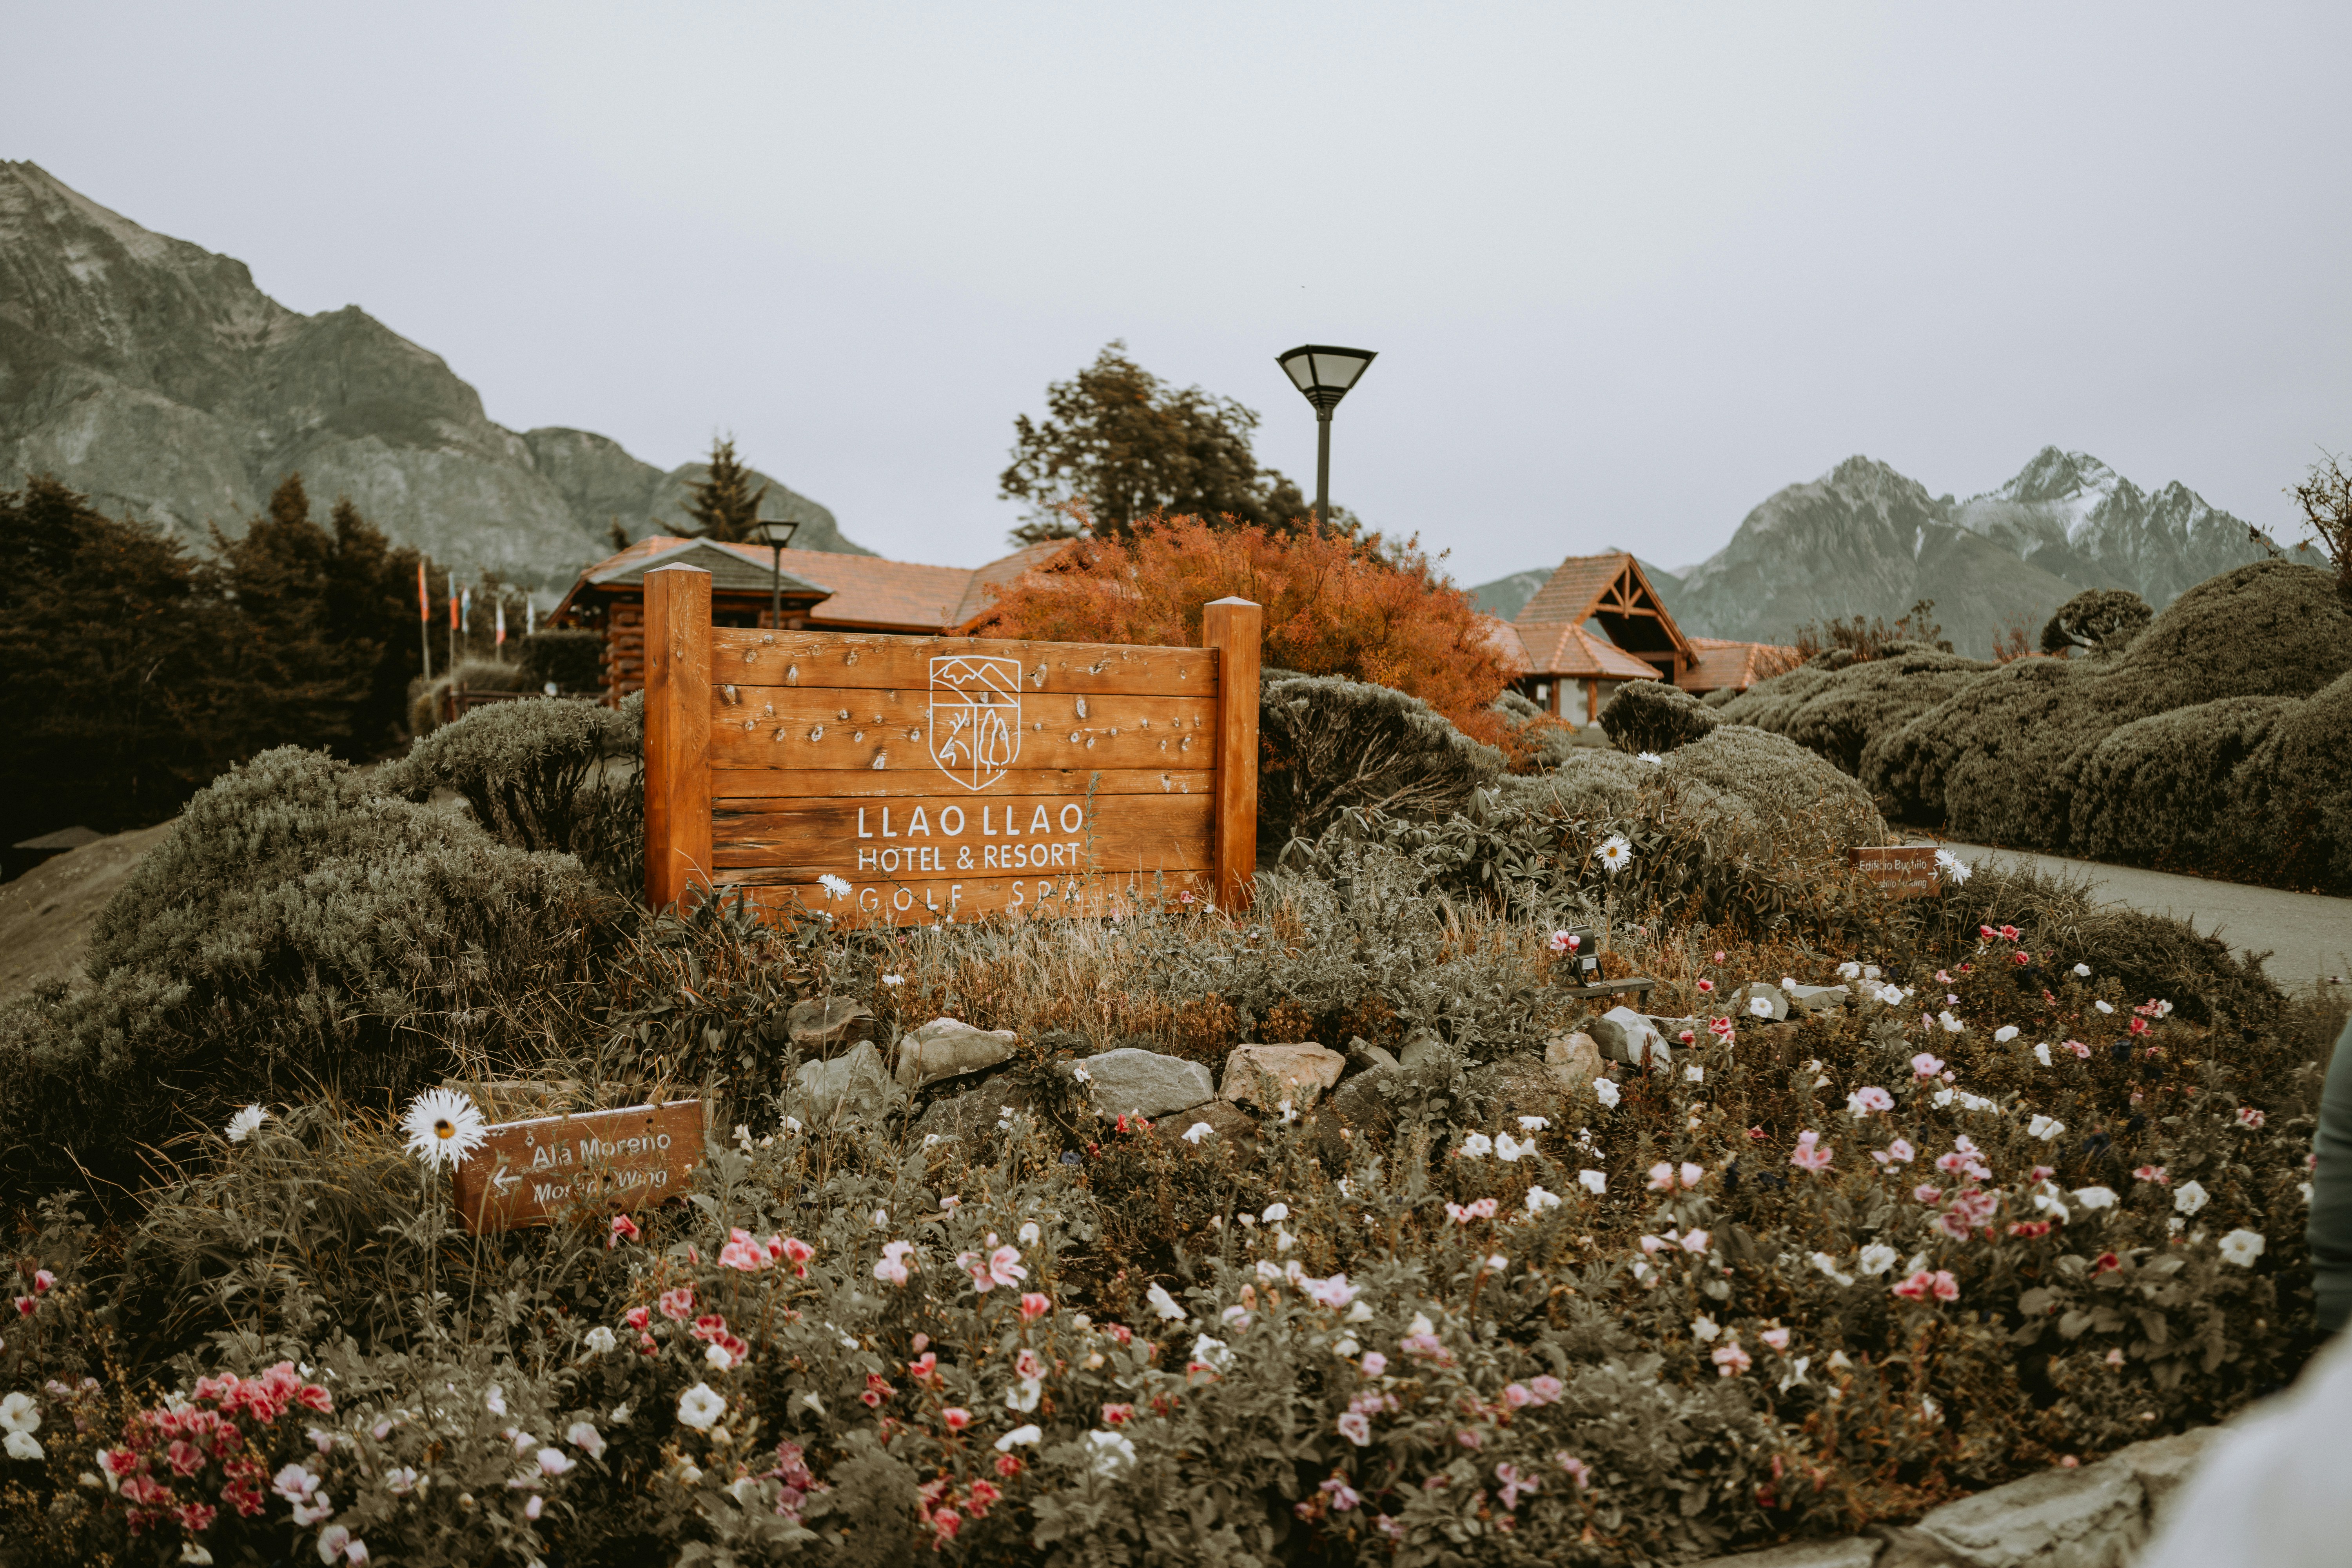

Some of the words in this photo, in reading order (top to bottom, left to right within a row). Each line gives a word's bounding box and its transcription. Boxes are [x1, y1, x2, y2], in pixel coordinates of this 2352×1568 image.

[858, 806, 965, 838] LLAO
[983, 803, 1083, 835] LLAO
[858, 846, 946, 872] HOTEL
[957, 846, 974, 870] &
[984, 842, 1080, 869] RESORT
[860, 884, 963, 912] GOLF
[1012, 880, 1080, 906] SPA
[1873, 877, 1896, 888] sillo
[532, 1143, 573, 1167] Ala
[580, 1133, 671, 1161] Moreno
[618, 1170, 668, 1188] Wing
